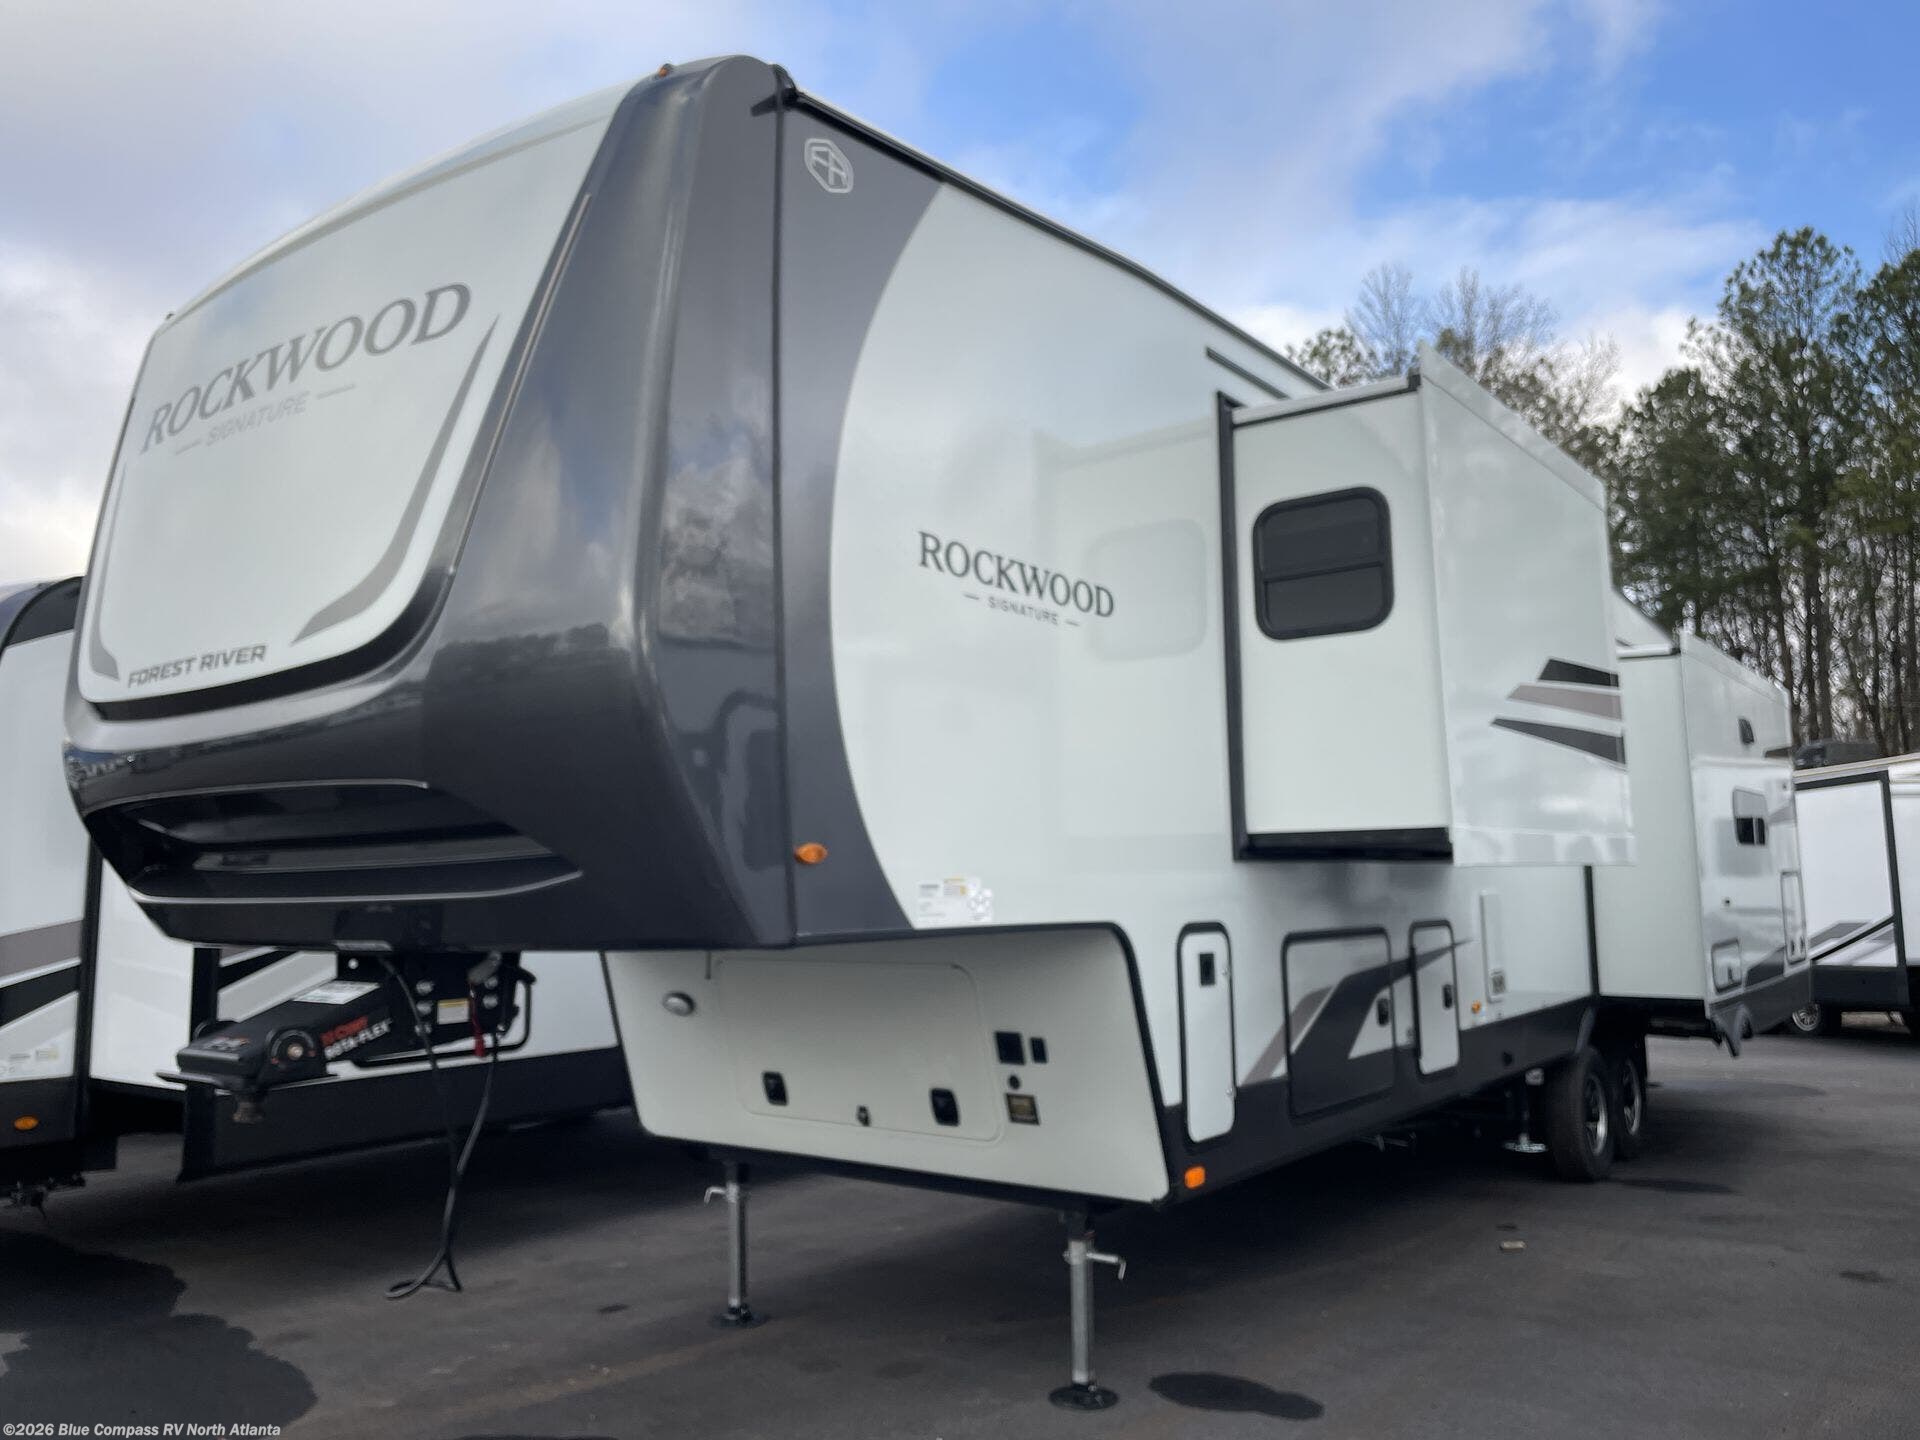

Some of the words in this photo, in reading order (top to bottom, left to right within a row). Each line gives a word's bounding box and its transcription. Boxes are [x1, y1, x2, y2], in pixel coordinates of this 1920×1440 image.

[139, 283, 472, 455] ROCKWOOD
[205, 391, 311, 447] SIGNATURE
[918, 531, 1115, 618] ROCKWOOD
[987, 596, 1060, 626] SIGNATURE
[127, 656, 198, 689] FOREST
[200, 644, 267, 672] RIVER
